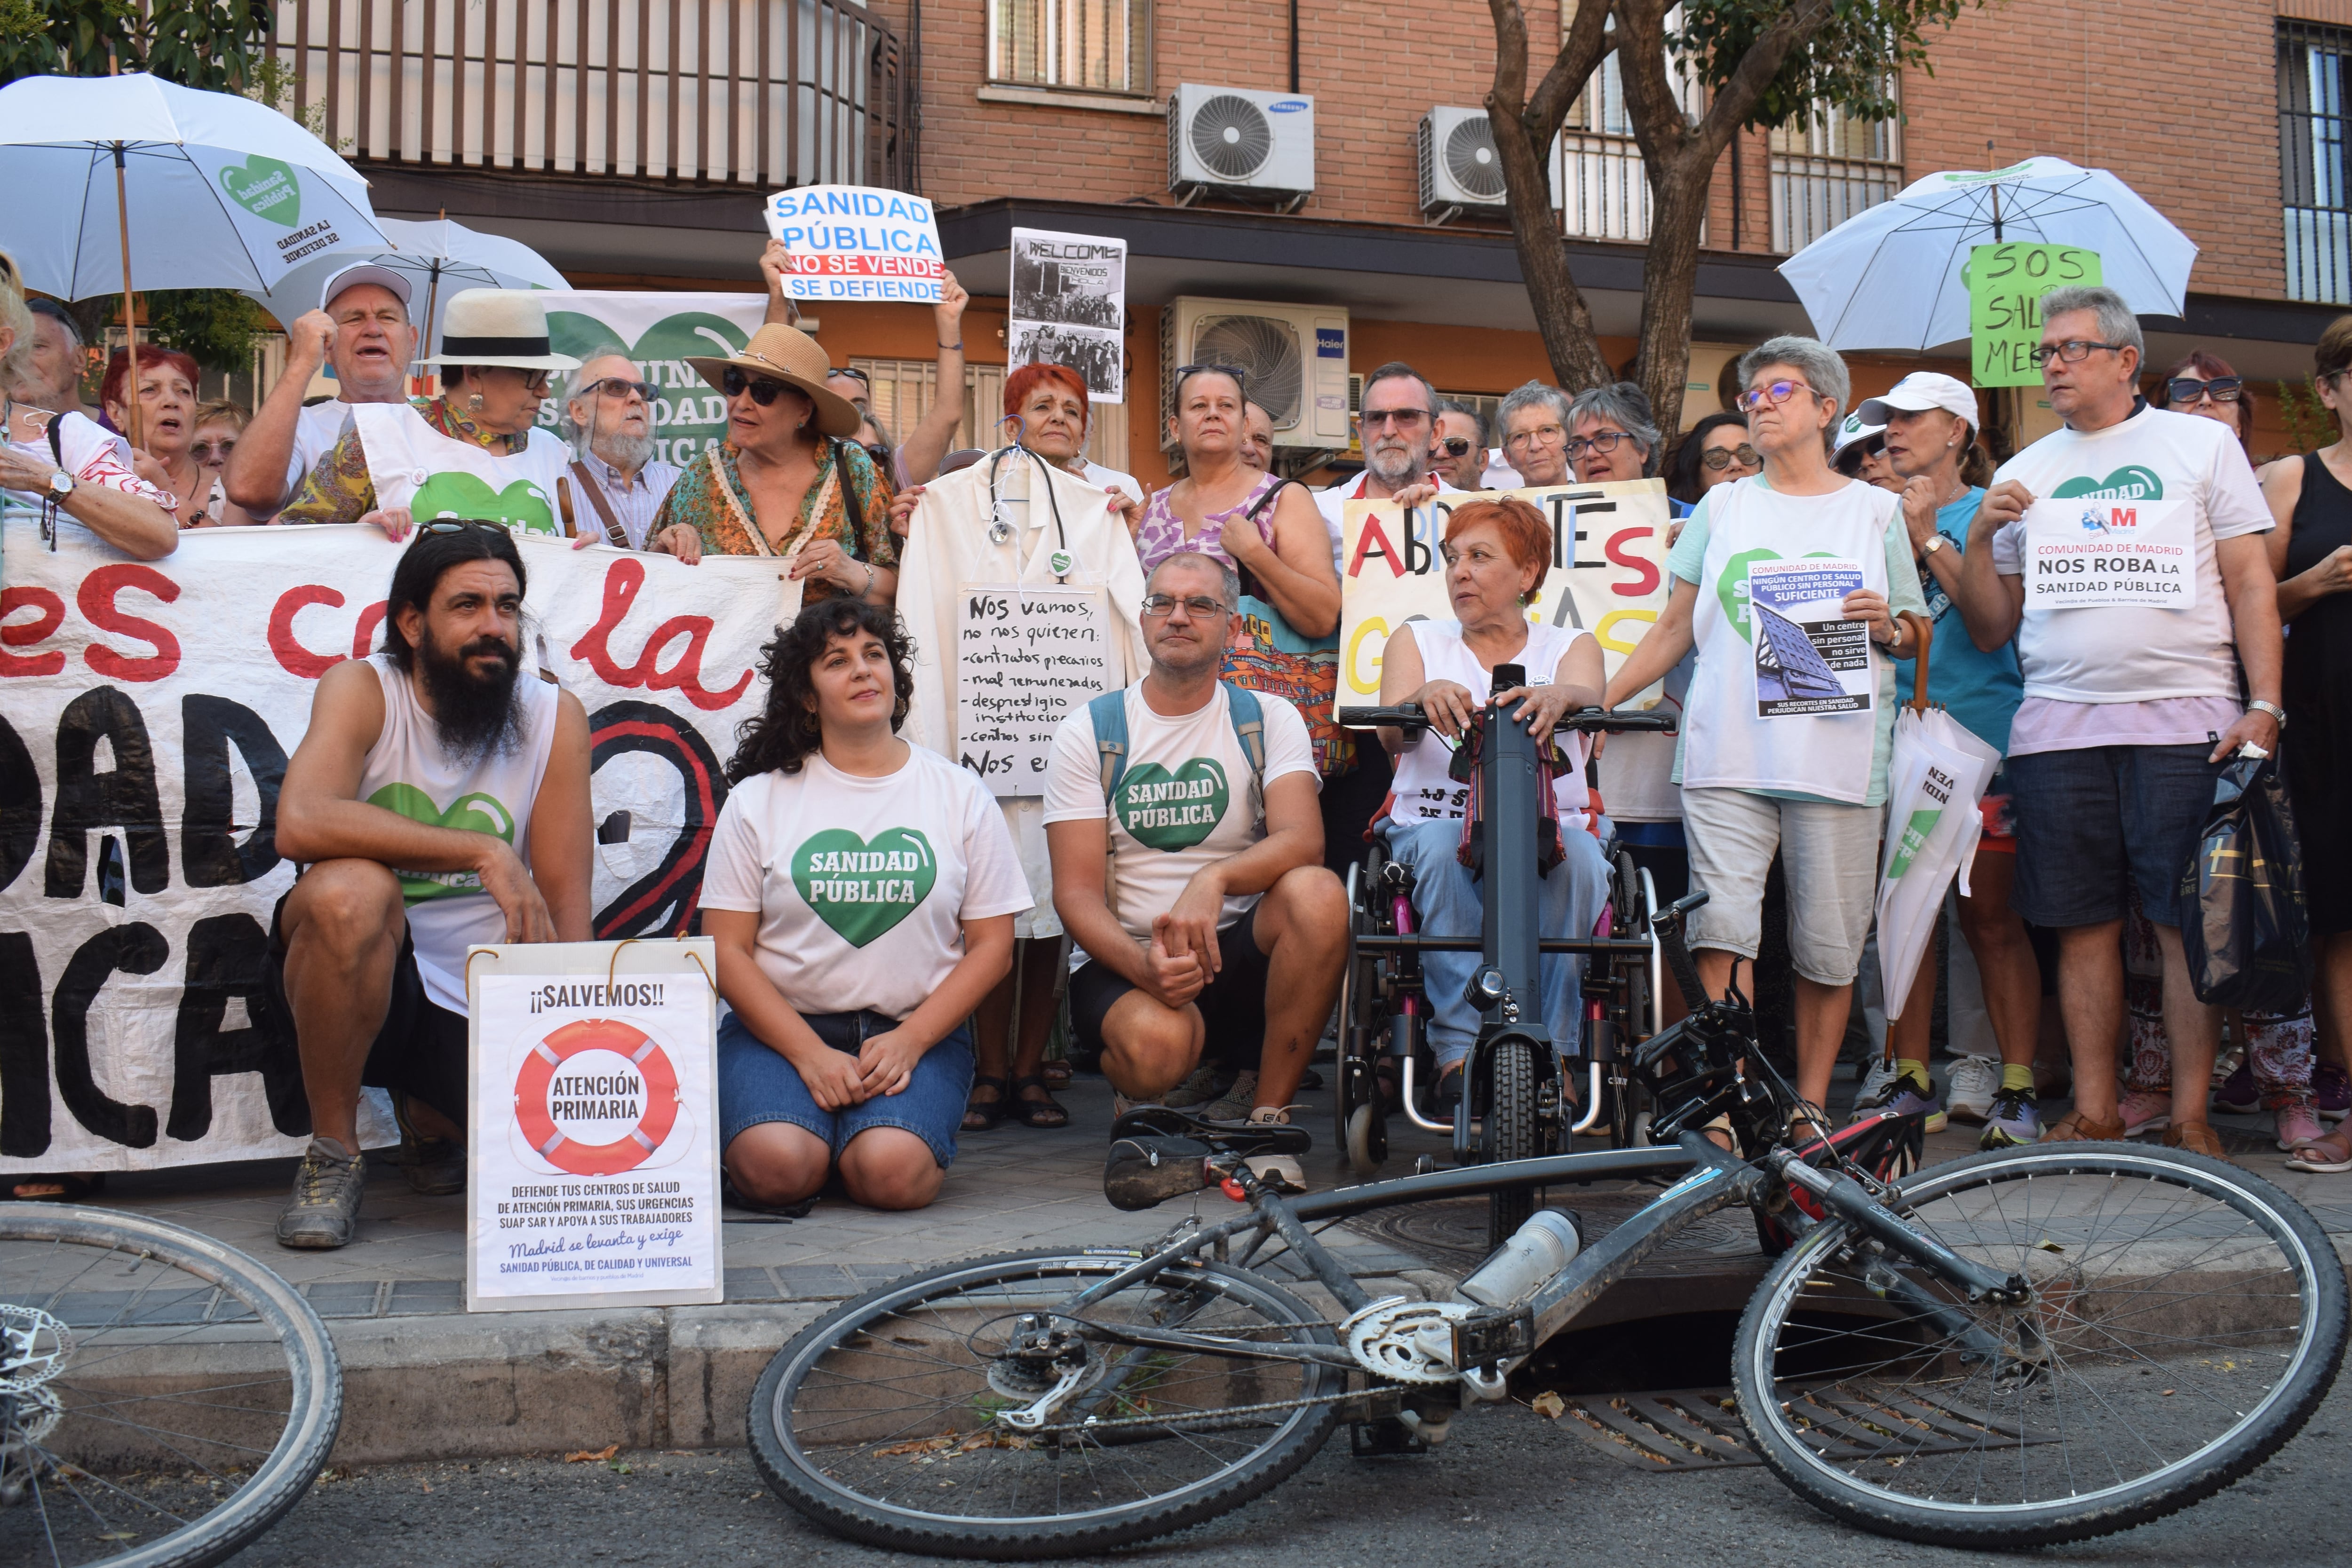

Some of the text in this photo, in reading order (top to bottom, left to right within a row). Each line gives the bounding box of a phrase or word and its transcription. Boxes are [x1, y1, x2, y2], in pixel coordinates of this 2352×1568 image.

[776, 192, 929, 223] SANIDAD
[782, 221, 938, 256] PÚBLICA
[1029, 242, 1119, 259] WELCOME
[791, 255, 942, 277] NO SE VENDE
[1986, 245, 2084, 279] SOS
[1060, 266, 1107, 276] BIENVENIDOS
[792, 279, 943, 300] SE DEFIENDE
[1317, 338, 1343, 349] Haier
[2111, 508, 2137, 526] M
[2038, 544, 2184, 556] COMUNIDAD DE MADRID
[1752, 564, 1807, 574] COMUNIDAD
[2038, 558, 2180, 574] NOS ROBA LA
[1752, 575, 1786, 585] NINGÚN
[1788, 574, 1820, 583] CENTRO
[2036, 578, 2182, 594] SANIDAD PÚBLICA
[1775, 588, 1840, 602] SUFICIENTE
[1021, 601, 1093, 621] vamos,
[571, 558, 754, 711] la
[963, 623, 1100, 647] no nos quieren:
[1822, 622, 1866, 632] Un centro
[1812, 633, 1866, 645] sin personal
[1844, 646, 1866, 655] sirve
[1044, 655, 1104, 671] precarios
[1843, 659, 1867, 668] nada.
[972, 672, 1003, 688] mal
[1009, 676, 1104, 691] remunerados
[972, 692, 1067, 713] desprestigio
[1029, 732, 1053, 742] sin
[1128, 778, 1214, 804] SANIDAD
[1128, 803, 1216, 830] PÚBLICA
[810, 851, 918, 872] SANIDAD
[810, 873, 915, 903] PÚBLICA
[531, 984, 664, 1014] ¡¡SALVEMOS!!
[553, 1070, 639, 1096] ATENCIÓN
[553, 1100, 639, 1120] PRIMARIA
[512, 1181, 680, 1197] DEFIENDE TUS CENTROS DE SALUD
[498, 1197, 693, 1214] DE ATENCIÓN PRIMARIA, SUS URGENCIAS
[500, 1212, 692, 1228] SUAP SAR Y APOYA A SUS TRABAJADORES
[509, 1228, 683, 1259] Madrid se levanta y exige
[500, 1256, 692, 1273] SANIDAD PÚBLICA, DE CALIDAD Y UNIVERSAL
